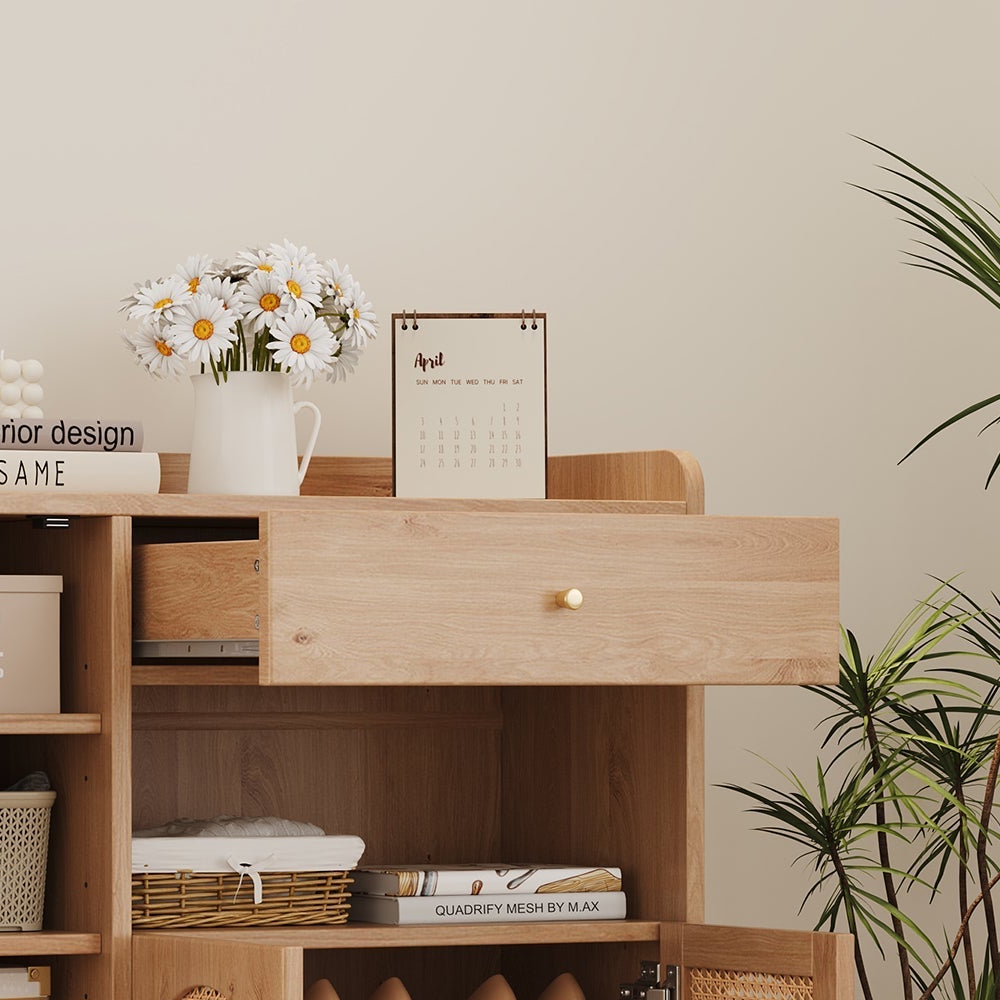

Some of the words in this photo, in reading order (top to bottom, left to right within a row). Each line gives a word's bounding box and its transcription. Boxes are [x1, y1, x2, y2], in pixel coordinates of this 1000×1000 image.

[414, 352, 445, 372] April
[51, 420, 135, 451] design
[435, 904, 503, 916] QUADRIFY
[506, 903, 544, 914] MESH
[547, 902, 565, 912] BY
[568, 901, 600, 912] M.AX
